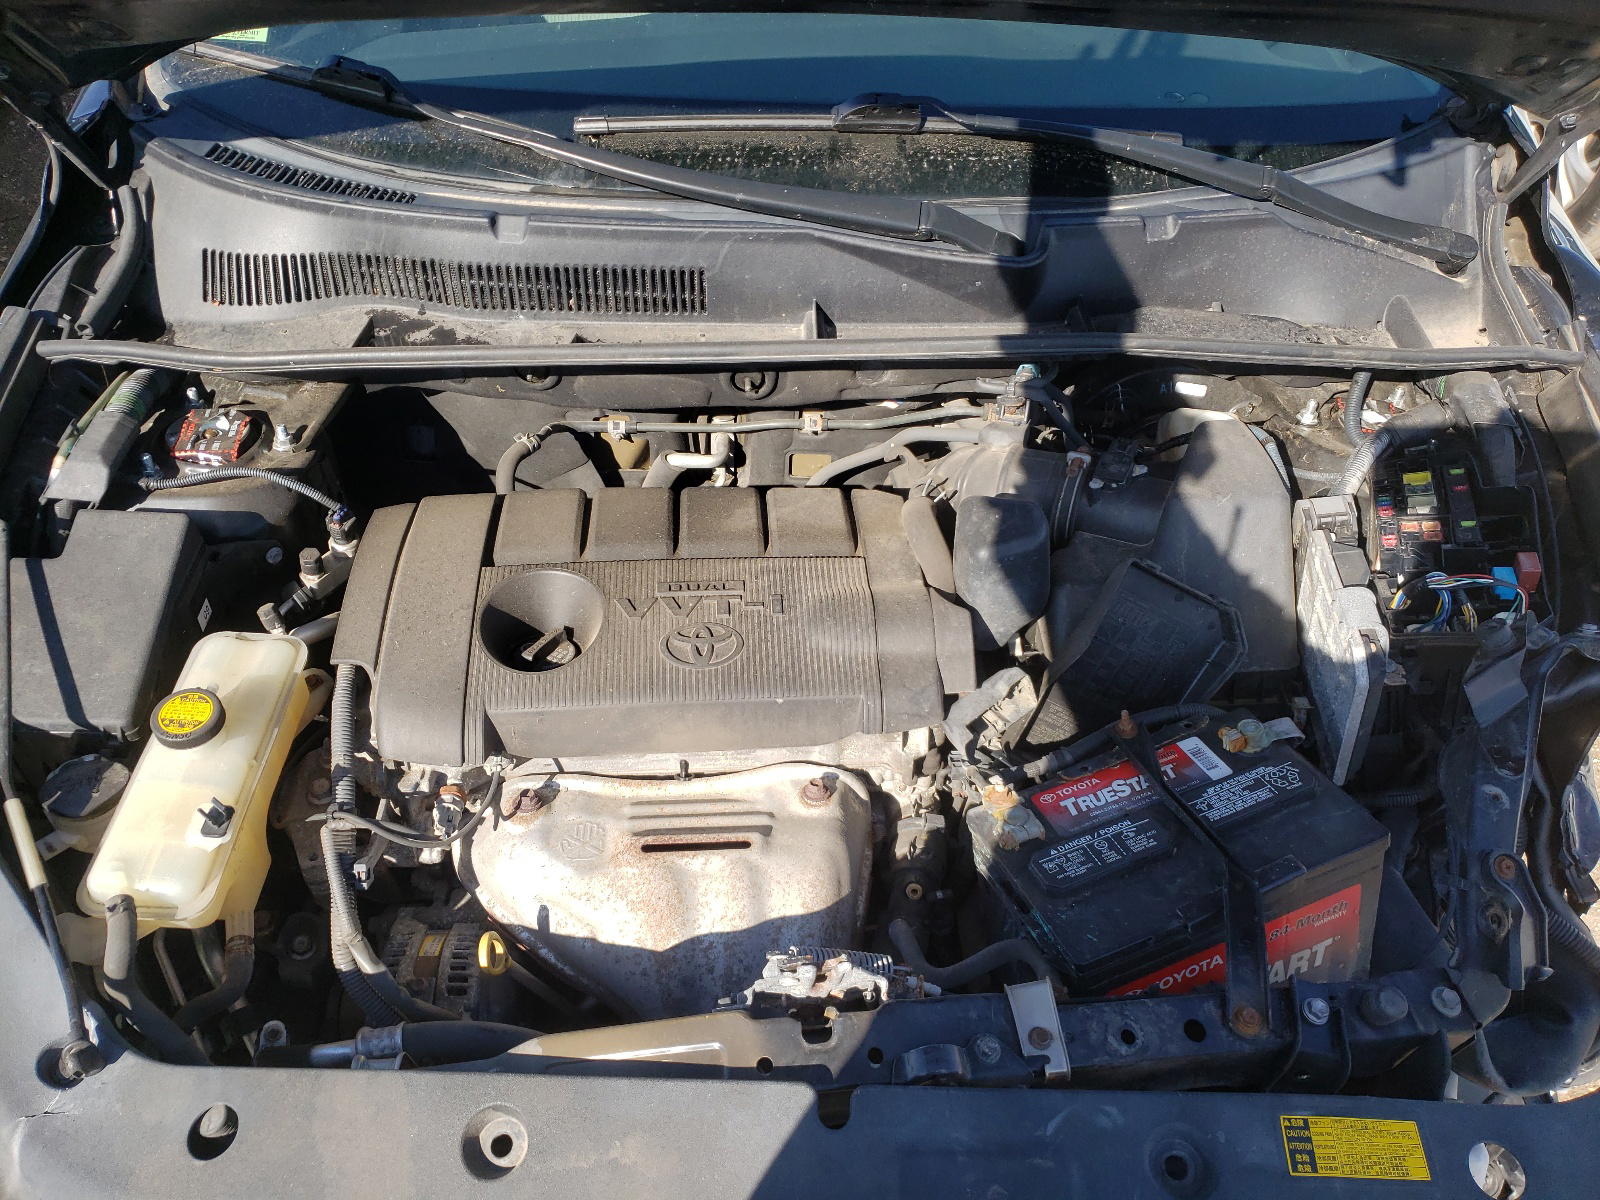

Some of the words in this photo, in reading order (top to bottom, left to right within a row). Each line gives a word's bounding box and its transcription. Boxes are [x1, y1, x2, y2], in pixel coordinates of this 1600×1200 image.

[668, 583, 737, 592] DUAL
[1056, 777, 1101, 797] TOYOTA
[1057, 835, 1093, 853] DANGER
[1099, 820, 1131, 837] POISON
[1266, 936, 1333, 985] ART
[1286, 1129, 1310, 1137] CAUTION
[1289, 1142, 1312, 1150] ATTENTION
